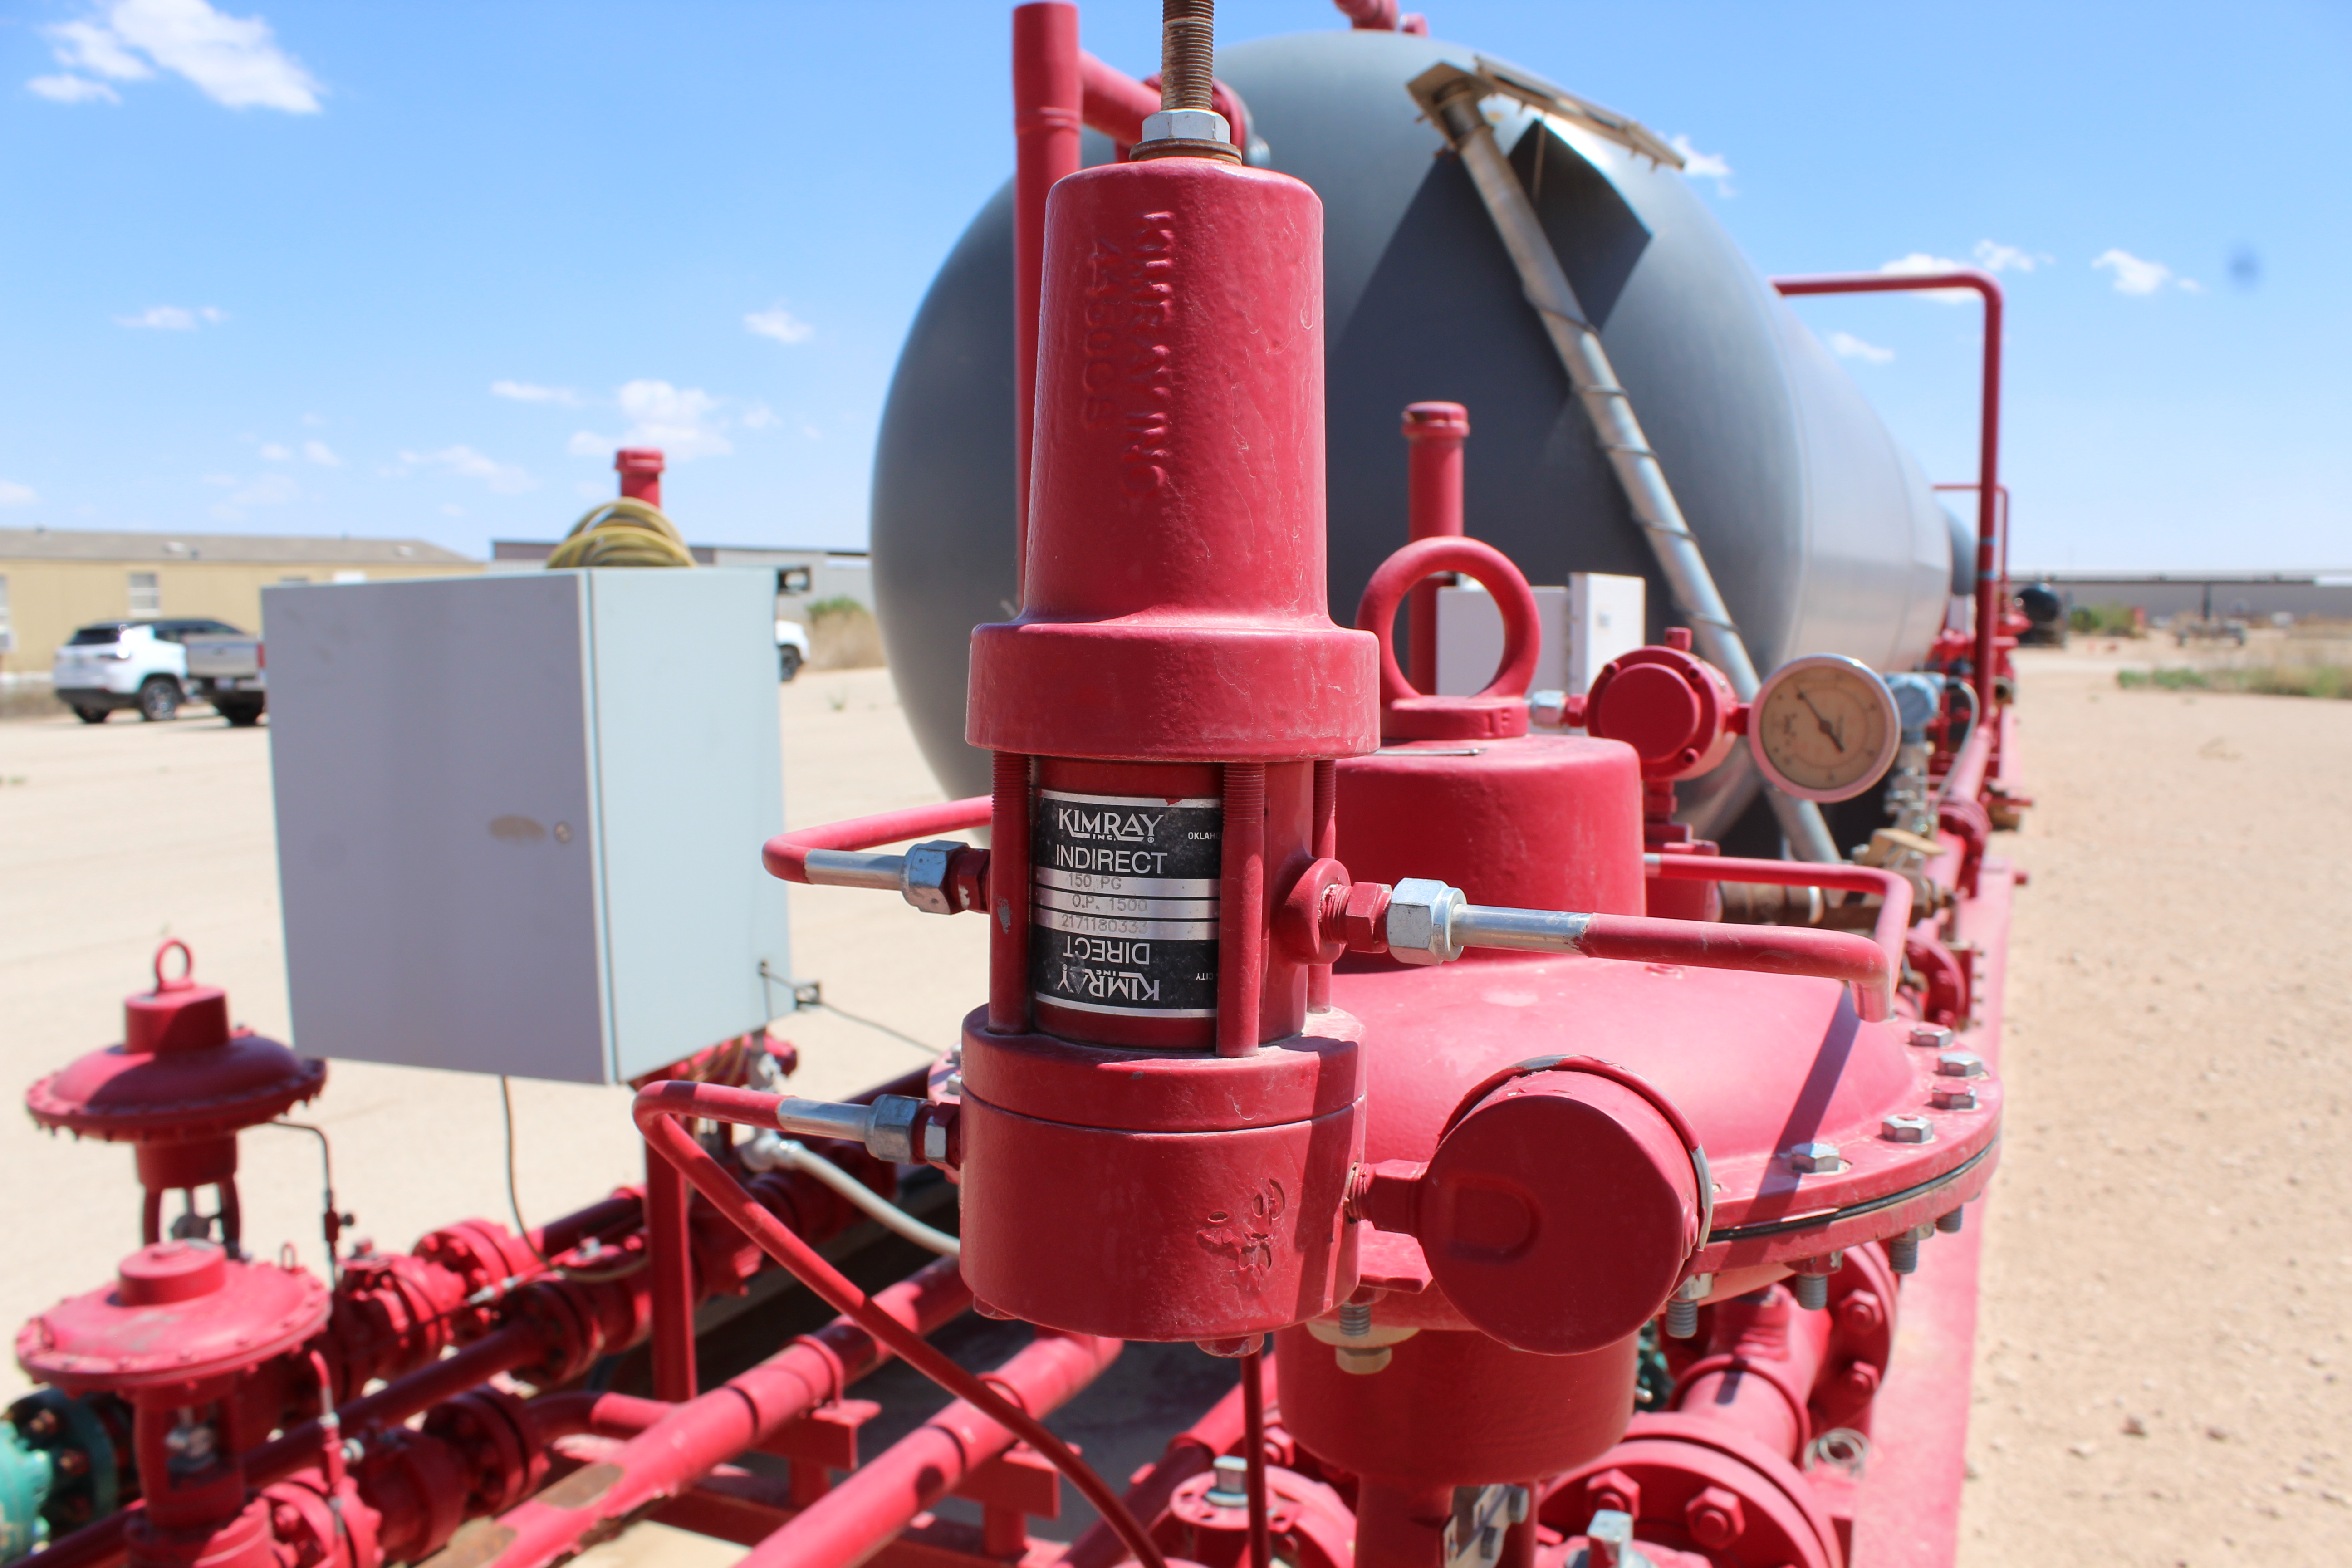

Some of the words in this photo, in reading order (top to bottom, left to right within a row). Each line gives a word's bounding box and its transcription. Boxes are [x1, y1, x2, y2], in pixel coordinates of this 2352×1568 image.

[1058, 808, 1164, 842] KIMRAY
[1056, 844, 1168, 874] INDIRECT
[1069, 872, 1092, 887] 150
[1101, 875, 1122, 890] PG
[1109, 897, 1148, 912] 1500
[1062, 913, 1149, 934] 2171180333
[1063, 936, 1150, 965] DIRECT
[1195, 972, 1214, 980] CITY
